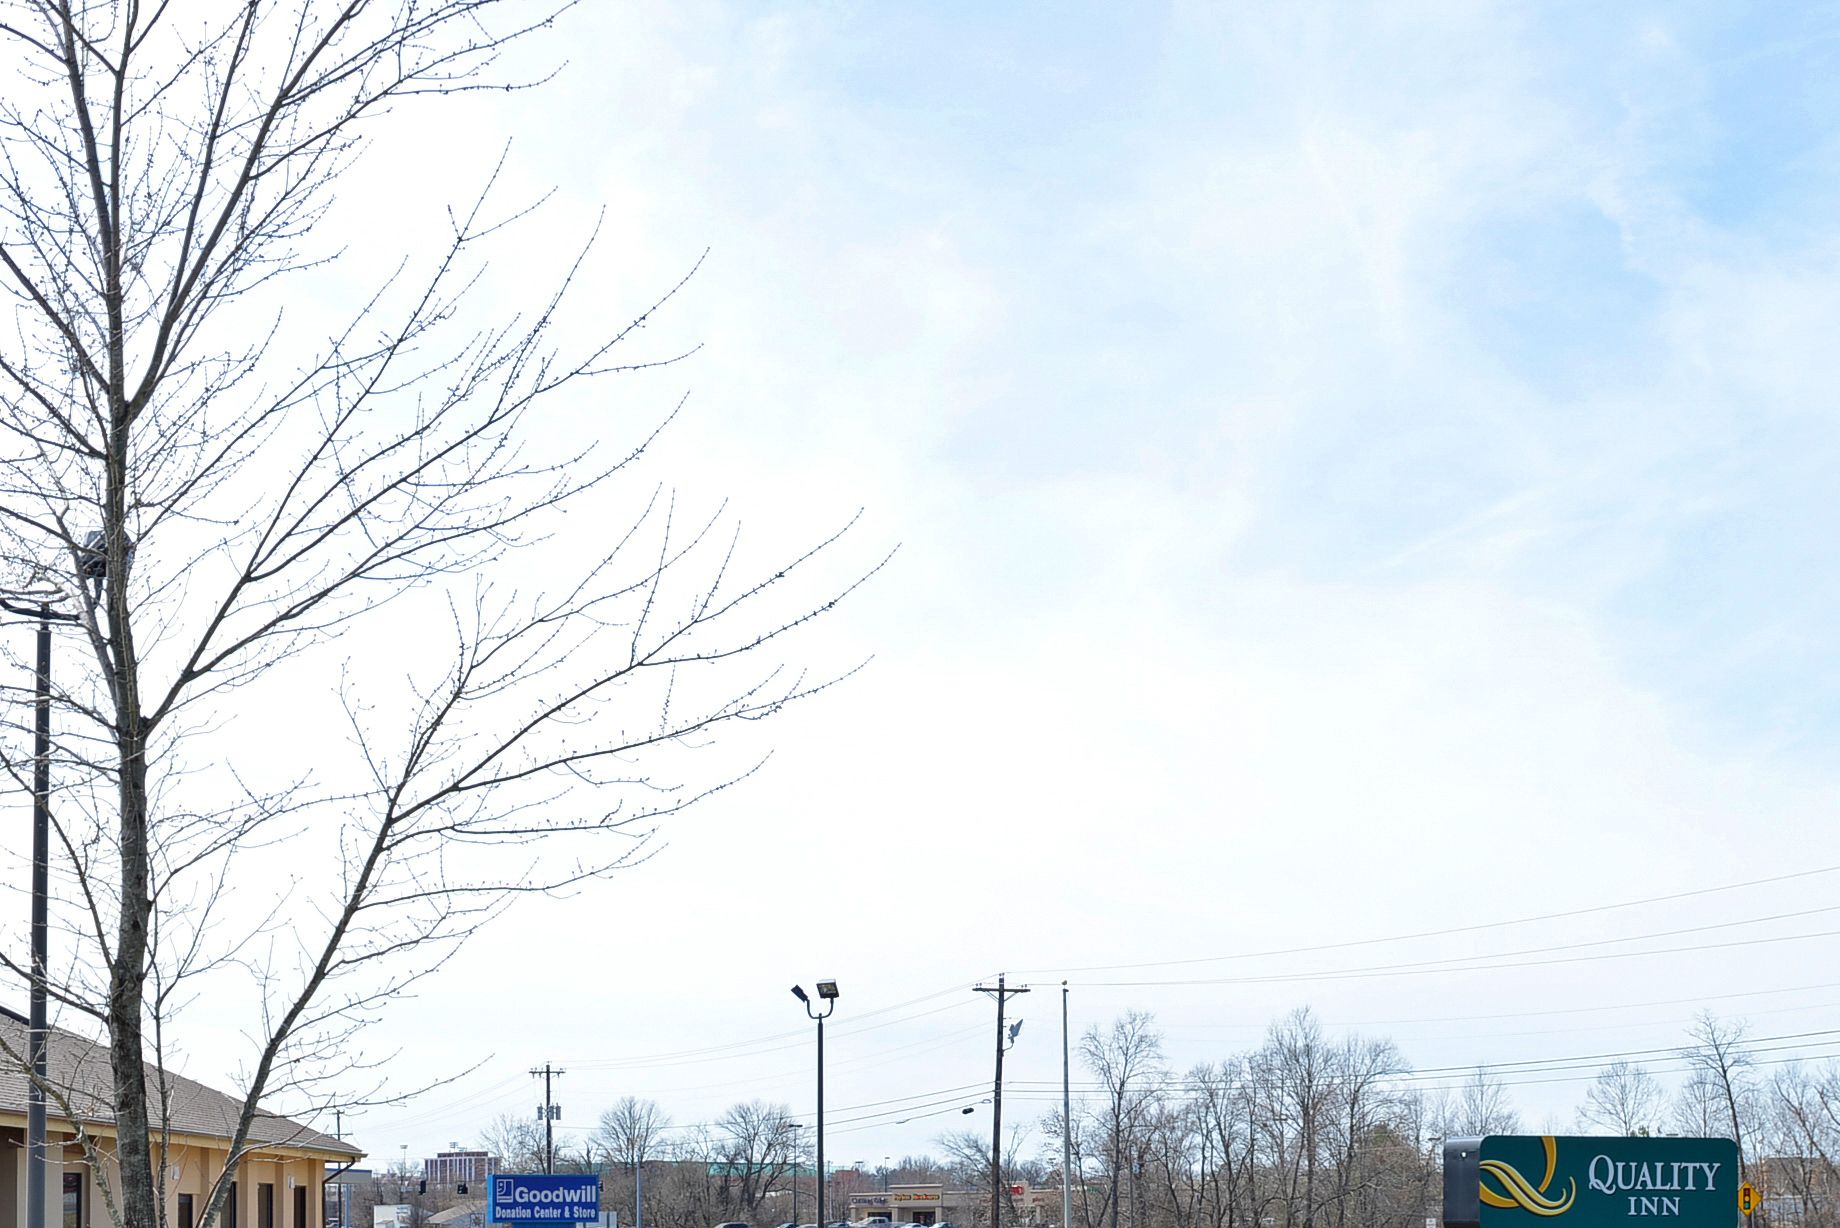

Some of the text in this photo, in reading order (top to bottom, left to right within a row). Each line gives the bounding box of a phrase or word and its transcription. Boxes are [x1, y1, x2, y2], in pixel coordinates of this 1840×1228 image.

[1588, 1154, 1721, 1195] QUALITY
[515, 1185, 597, 1203] Goodwill
[495, 1206, 596, 1218] Donation Center & Store
[1627, 1196, 1681, 1216] INN
